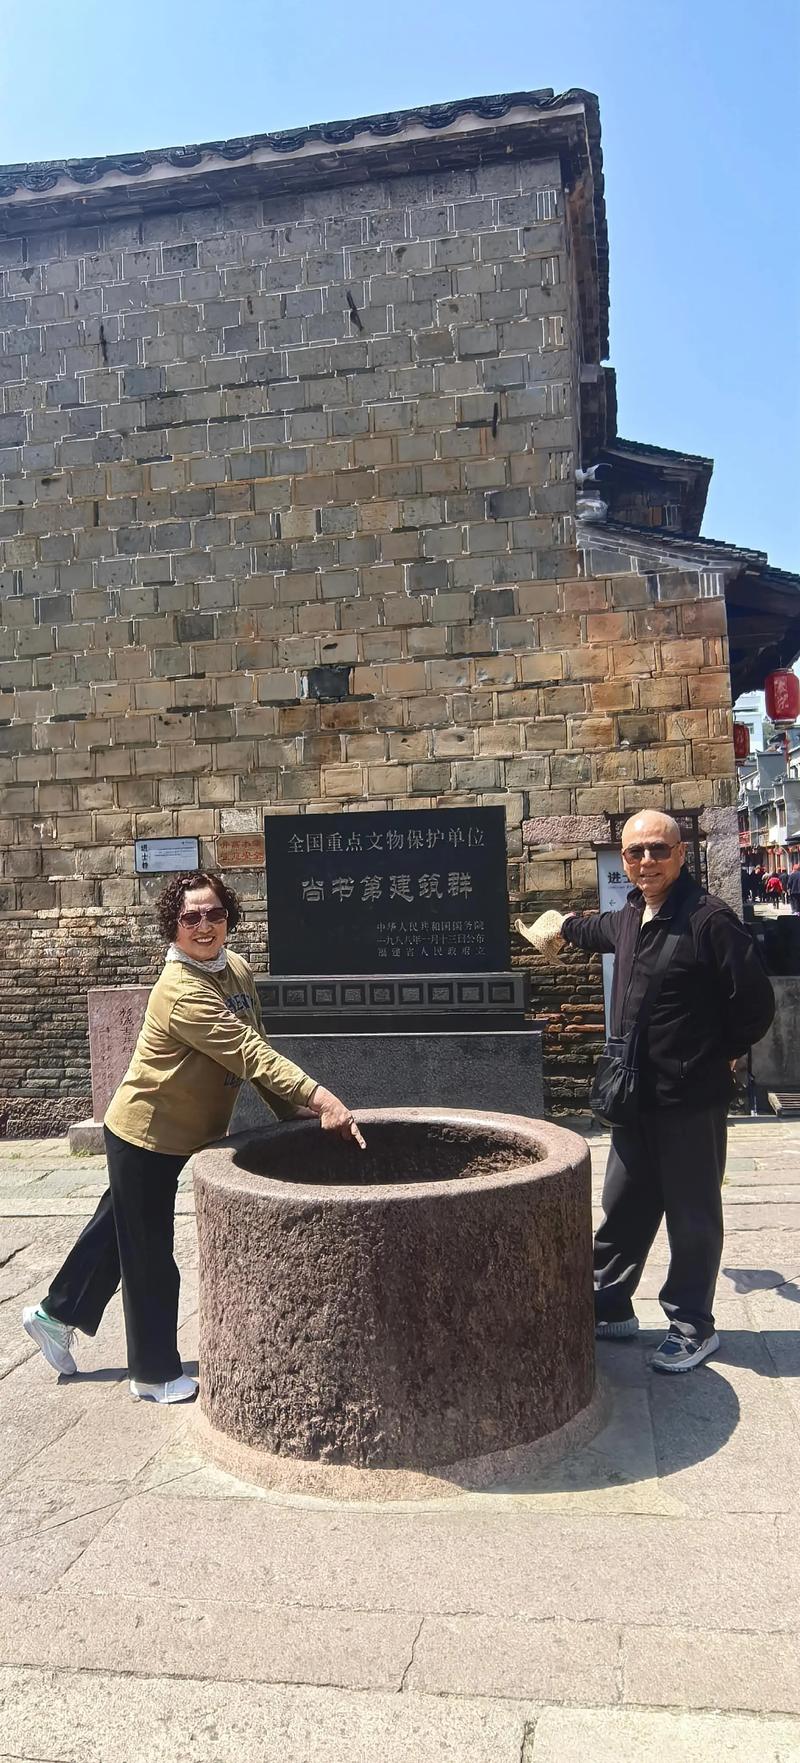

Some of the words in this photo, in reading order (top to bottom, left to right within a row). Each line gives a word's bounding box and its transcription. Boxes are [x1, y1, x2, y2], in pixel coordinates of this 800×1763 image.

[287, 826, 485, 853] 全国重点文物保护单位
[301, 871, 473, 902] 尚书第建筑群
[376, 920, 485, 933] 中华人民共和国国务院
[376, 933, 485, 945] 一九八八年一月十三日公布
